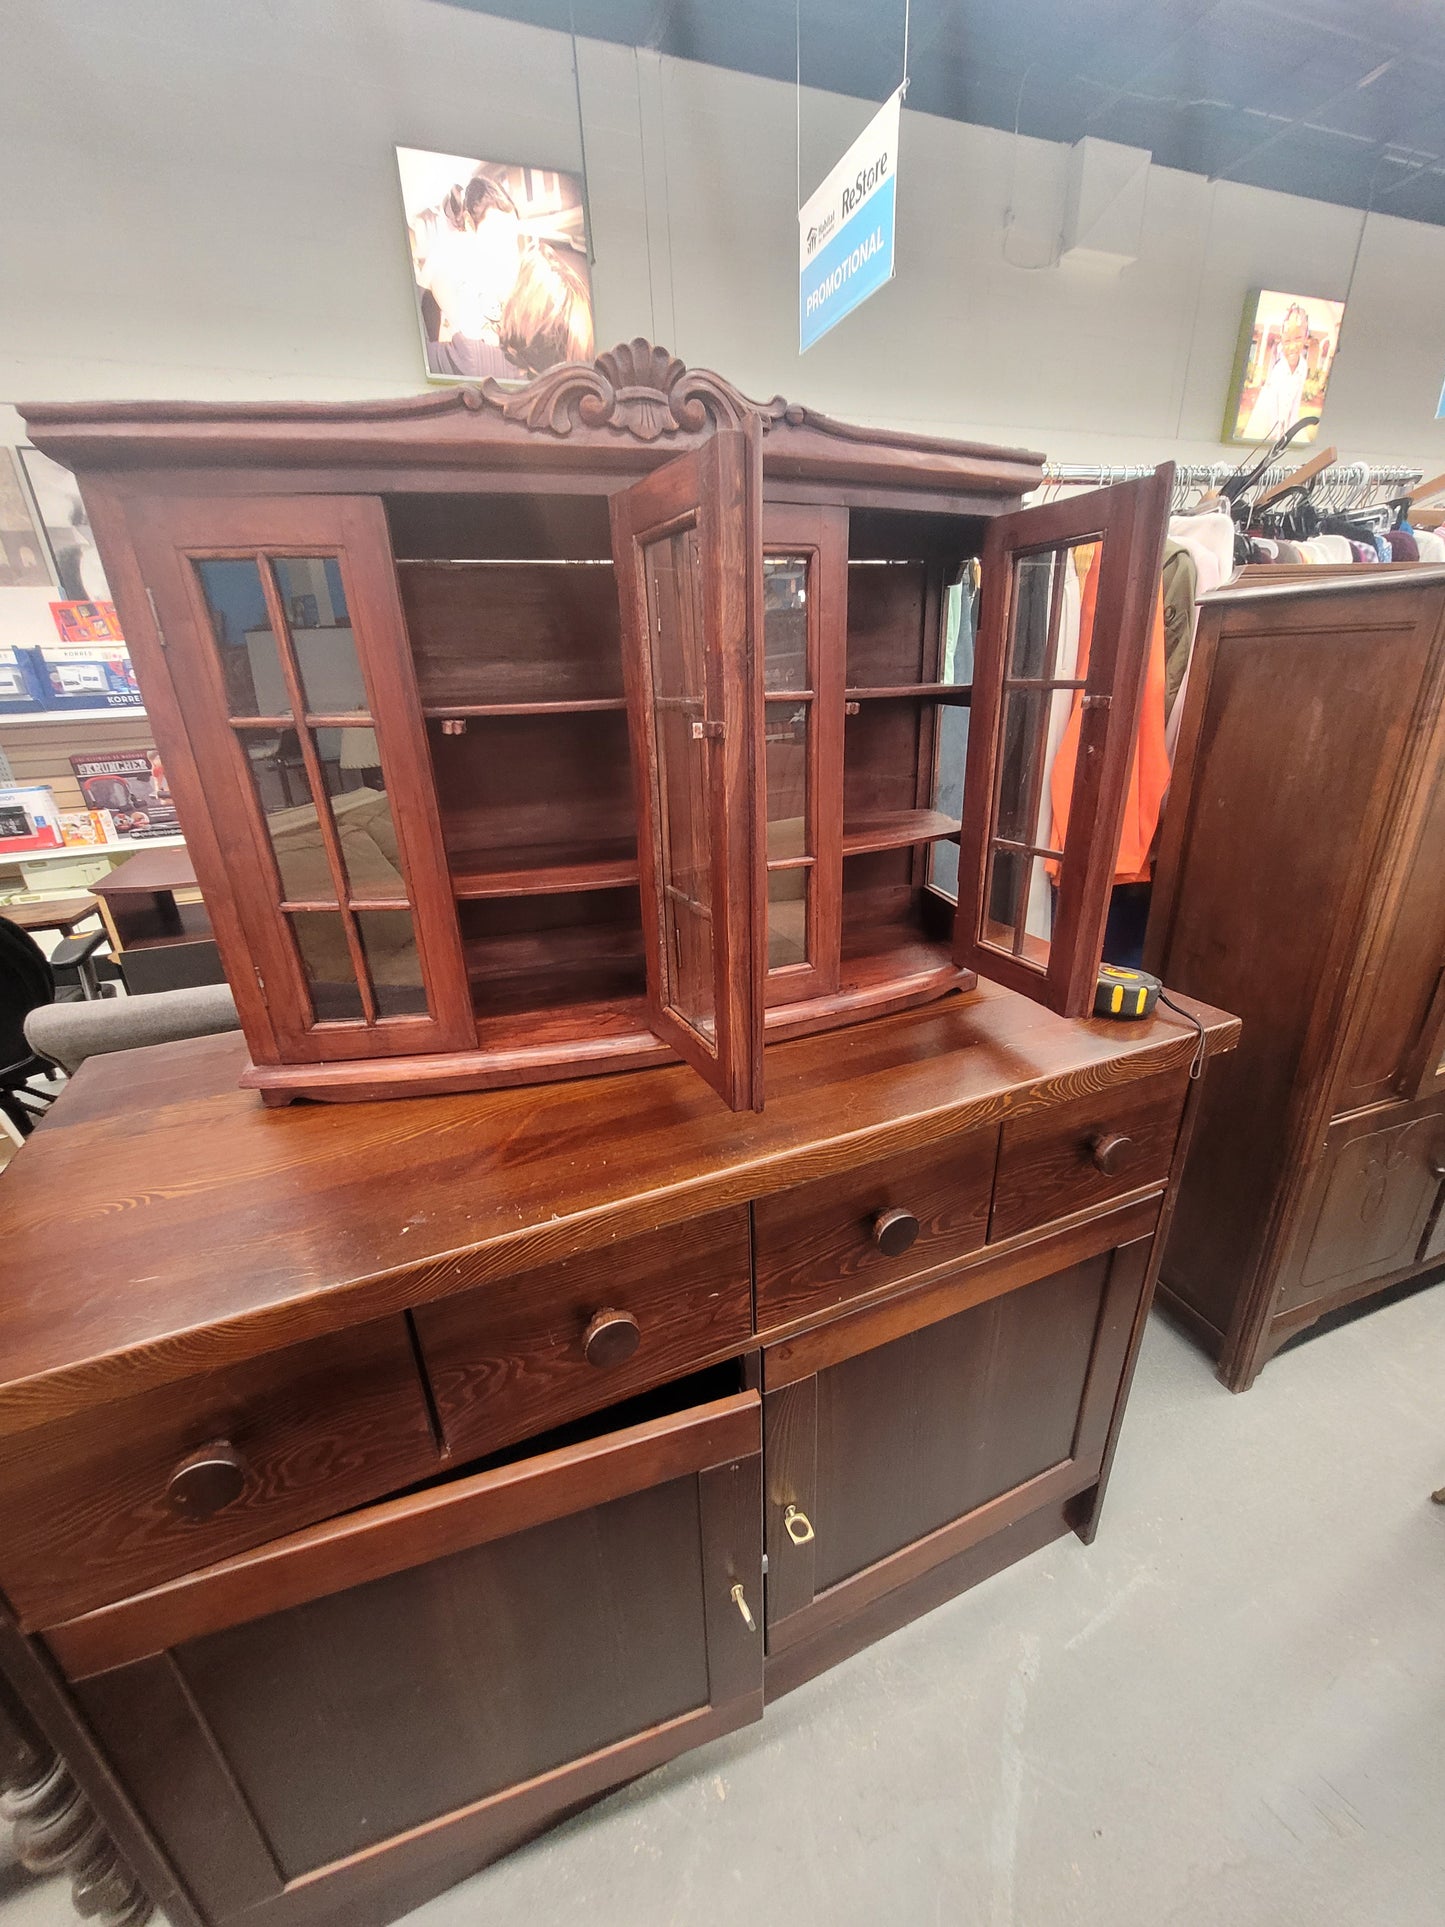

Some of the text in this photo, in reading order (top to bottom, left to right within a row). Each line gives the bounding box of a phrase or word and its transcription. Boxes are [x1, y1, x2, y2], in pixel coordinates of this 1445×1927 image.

[841, 152, 888, 219] ReStore
[806, 225, 885, 318] PROMOTIONAL
[107, 694, 143, 704] KORRE
